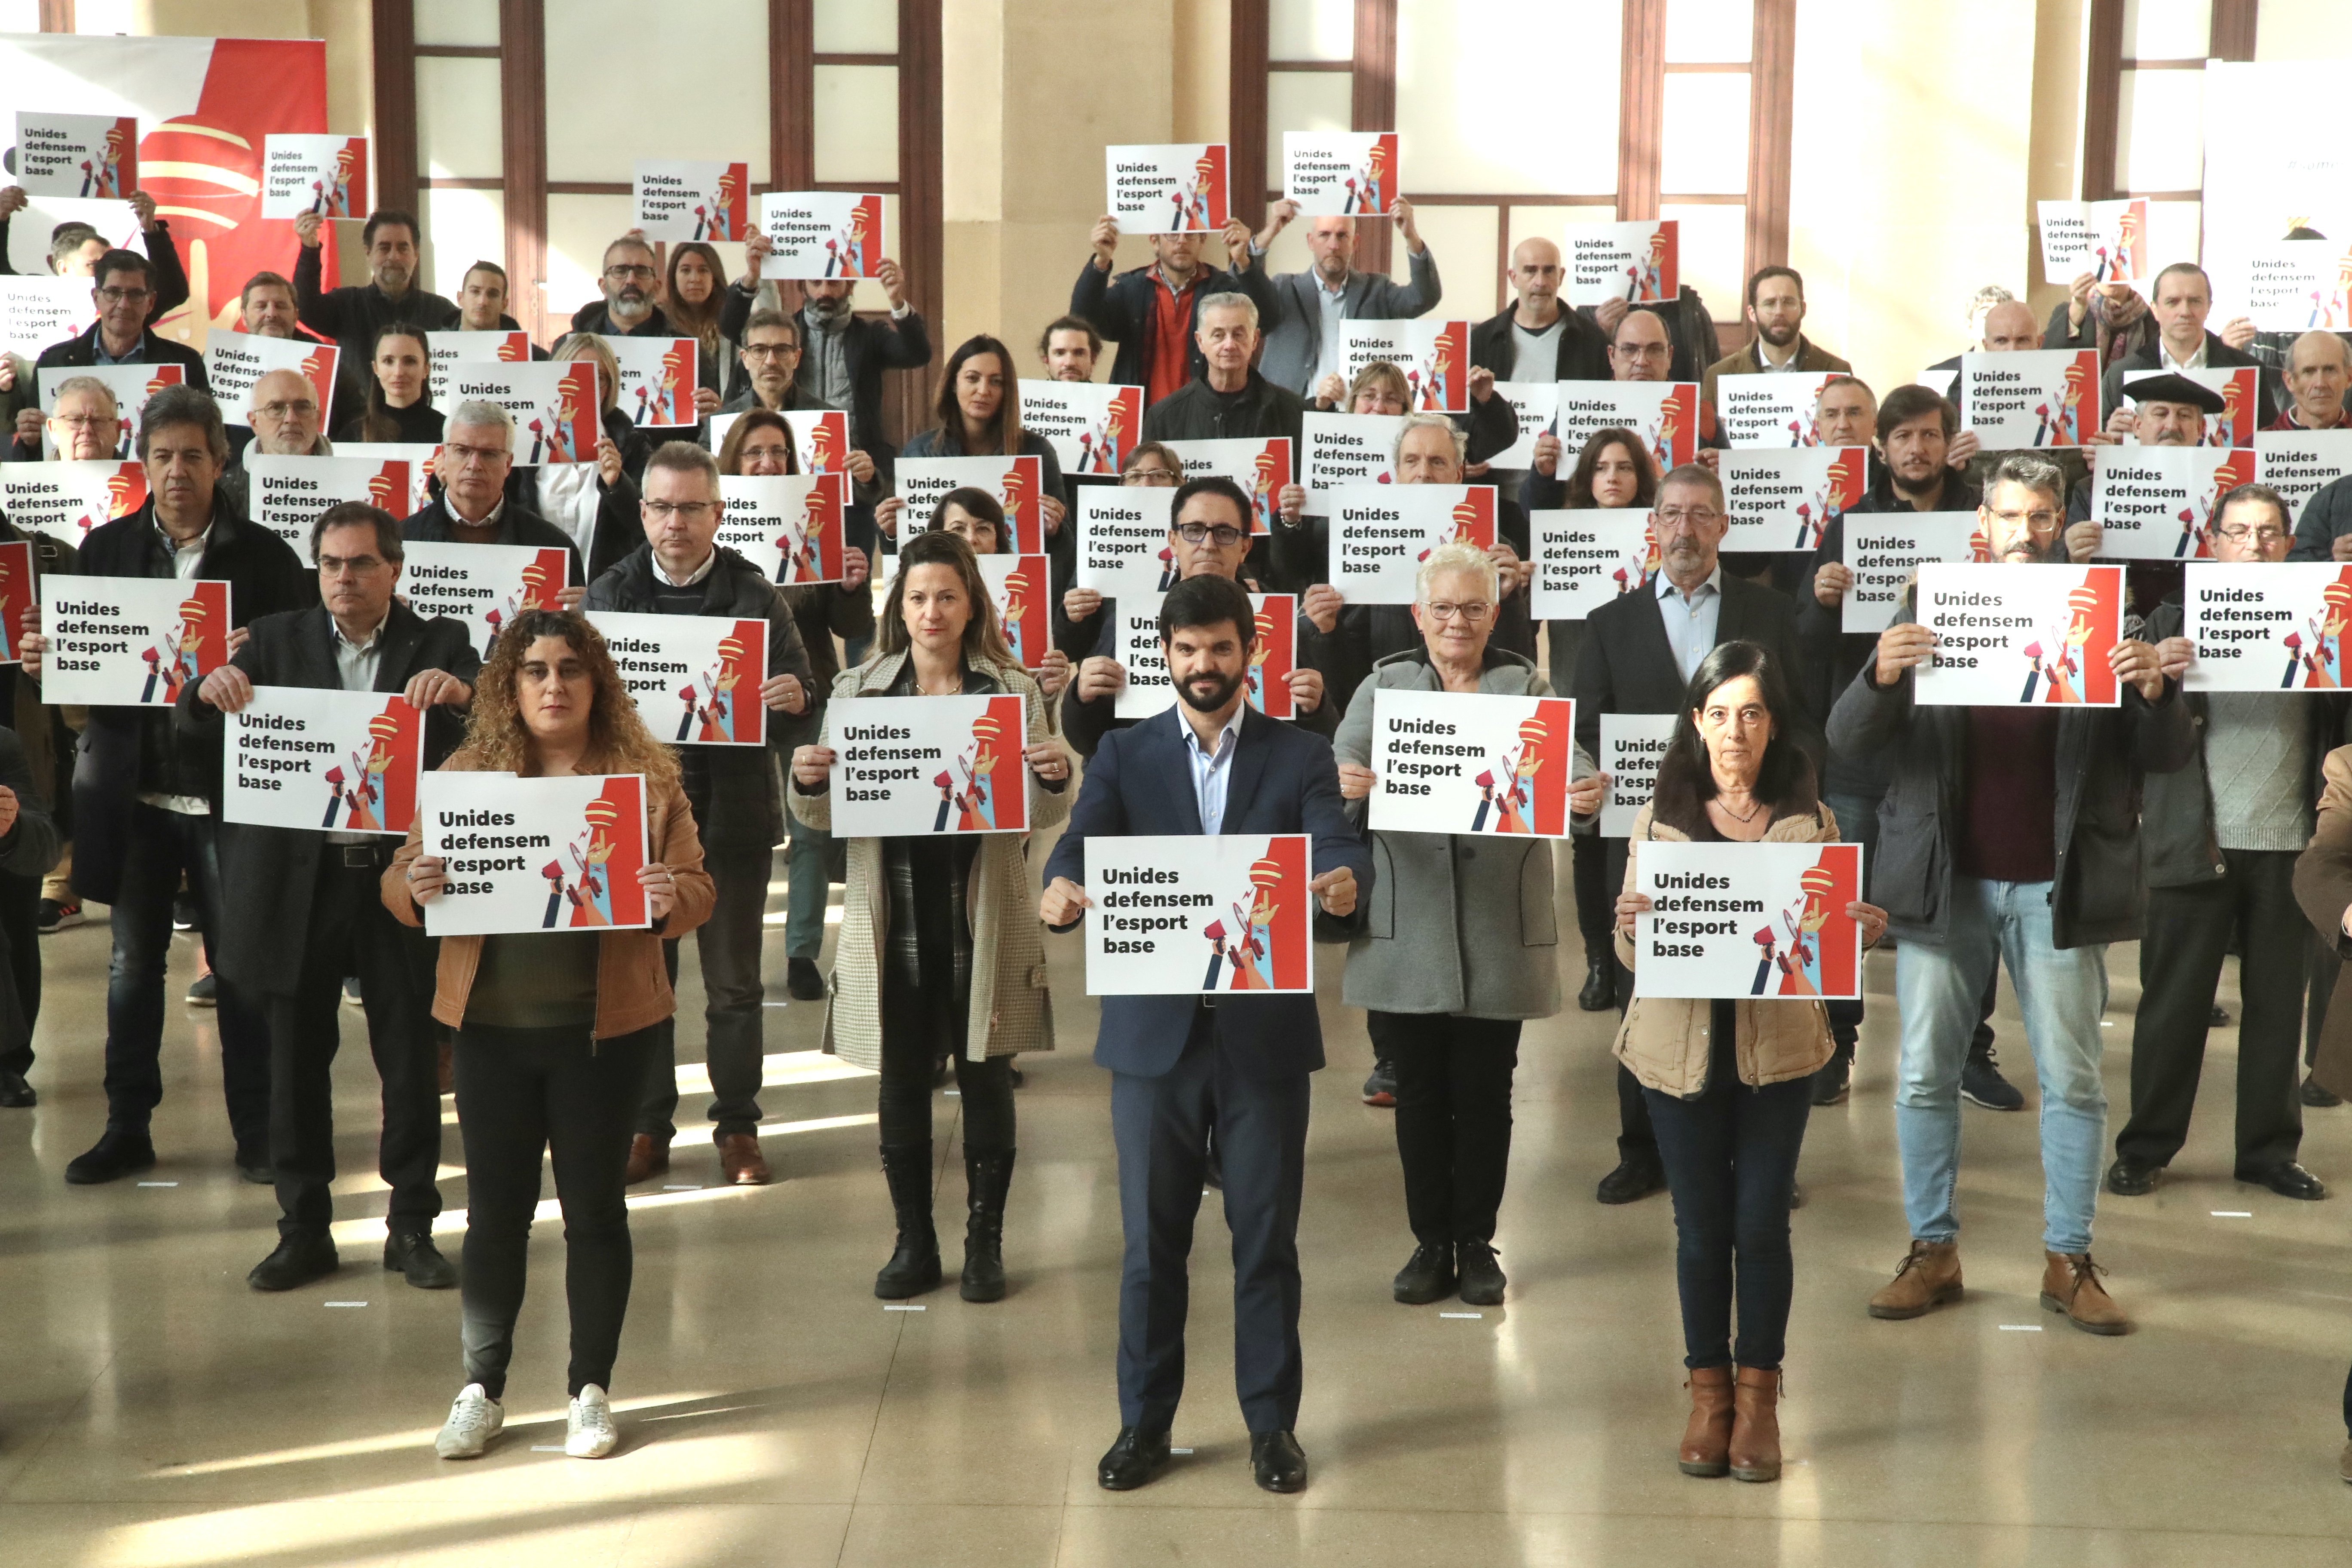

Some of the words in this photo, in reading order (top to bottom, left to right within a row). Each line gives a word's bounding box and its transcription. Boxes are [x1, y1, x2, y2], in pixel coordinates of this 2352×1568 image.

[25, 129, 67, 139] Unides
[25, 141, 86, 152] defensem
[25, 153, 71, 165] l'esport
[272, 151, 302, 160] Unides
[26, 166, 54, 175] base
[271, 164, 318, 172] defensem
[1117, 163, 1158, 172] Unides
[1294, 162, 1350, 170] defensem
[270, 176, 305, 186] l'esport
[643, 175, 682, 185] Unides
[1117, 176, 1176, 185] defensem
[1294, 174, 1337, 184] l'esport
[643, 187, 700, 198] defensem
[1117, 190, 1162, 200] l'esport
[1293, 186, 1320, 195] base
[643, 199, 686, 211] l'esport
[1118, 202, 1145, 211] base
[643, 211, 669, 220] base
[772, 209, 812, 218] Unides
[772, 222, 830, 231] defensem
[2047, 218, 2084, 227] Unides
[771, 235, 817, 245] l'esport
[2048, 231, 2100, 240] defensem
[1575, 239, 1614, 248] Unides
[1576, 252, 1632, 260] defensem
[2049, 254, 2071, 263] base
[1576, 264, 1618, 274] l'esport
[2253, 259, 2295, 268] Unides
[8, 294, 51, 302] Unides
[9, 306, 71, 315] defensem
[1350, 338, 1393, 348] Unides
[215, 348, 259, 363] Unides
[214, 362, 268, 377] defense
[1973, 371, 2020, 382] Unides
[460, 383, 511, 394] Unides
[1973, 386, 2042, 396] defensem
[1729, 392, 1773, 401] Unides
[1025, 398, 1067, 409] Unides
[1569, 400, 1616, 411] Unides
[1729, 405, 1793, 414] defensem
[1973, 401, 2025, 413] l'esport
[1024, 412, 1086, 424] defensem
[1568, 415, 1637, 427] defensem
[1729, 418, 1778, 429] l'esport
[1972, 416, 2004, 425] base
[1314, 433, 1363, 445] Unides
[1729, 430, 1758, 441] base
[1314, 449, 1384, 462] defensem
[2266, 451, 2317, 462] Unides
[1313, 463, 1367, 478] l'esport
[1731, 469, 1780, 480] Unides
[2107, 468, 2162, 480] Unides
[2265, 467, 2340, 478] defensem
[6, 482, 58, 494] Unides
[263, 477, 318, 490] Unides
[907, 477, 956, 489] Unides
[1731, 484, 1802, 495] defensem
[2106, 485, 2186, 498] defensem
[7, 498, 83, 509] defensem
[1730, 500, 1785, 512] l'esport
[2105, 501, 2166, 516] l'esport
[7, 512, 66, 524] l'esport
[263, 510, 321, 524] l'espor
[720, 515, 781, 526] efensem
[1090, 508, 1141, 521] Unides
[1343, 508, 1399, 521] Unides
[1730, 515, 1764, 525] base
[2104, 518, 2141, 530] base
[1090, 525, 1165, 537] defensem
[1343, 526, 1424, 538] defensem
[1543, 531, 1595, 543] Unides
[717, 532, 764, 544] esport
[1858, 536, 1915, 550] Unides
[1089, 541, 1147, 555] l'esport
[1343, 544, 1406, 558] l'esport
[1544, 548, 1619, 559] defensem
[1089, 557, 1124, 569] base
[1343, 561, 1381, 573] base
[410, 565, 468, 579] Unides
[1544, 564, 1601, 577] l'esport
[1544, 580, 1578, 591] base
[1857, 573, 1907, 587] l'espo
[410, 583, 493, 598] defensem
[1857, 590, 1896, 601] base
[2201, 588, 2263, 602] Unides
[1935, 591, 2002, 606] Unides
[57, 601, 119, 616] Unides
[2200, 608, 2292, 621] defensem
[1130, 617, 1159, 631] Uni
[1934, 613, 2032, 627] defensem
[57, 620, 149, 635] defensem
[2200, 627, 2270, 643] l'esport
[57, 639, 128, 655] l'esport
[2199, 646, 2242, 658] base
[58, 657, 100, 671] base
[1932, 654, 1978, 668] base
[1129, 672, 1171, 687] base
[239, 714, 305, 732] Unides
[1390, 718, 1456, 735] Unides
[845, 725, 910, 740] Unides
[239, 734, 335, 753] defensem
[1388, 739, 1485, 757] defensem
[1614, 739, 1669, 753] Unide
[845, 746, 941, 761] defensem
[239, 753, 311, 773] l'esport
[1387, 759, 1461, 778] l'esport
[239, 773, 282, 790] base
[845, 767, 919, 784] l'esport
[1386, 780, 1431, 795] base
[1614, 775, 1655, 789] l'esp
[846, 787, 891, 801] base
[440, 809, 514, 827] Unides
[441, 833, 550, 850] defensem
[441, 856, 526, 874] l'esport
[1103, 867, 1179, 884] Unides
[1655, 872, 1730, 889] Unides
[443, 879, 493, 895] base
[1104, 891, 1213, 907] defensem
[1654, 896, 1763, 912] defensem
[1104, 915, 1188, 934] l'esport
[1654, 918, 1737, 938] l'esport
[1104, 937, 1155, 953] base
[1654, 941, 1704, 957] base
